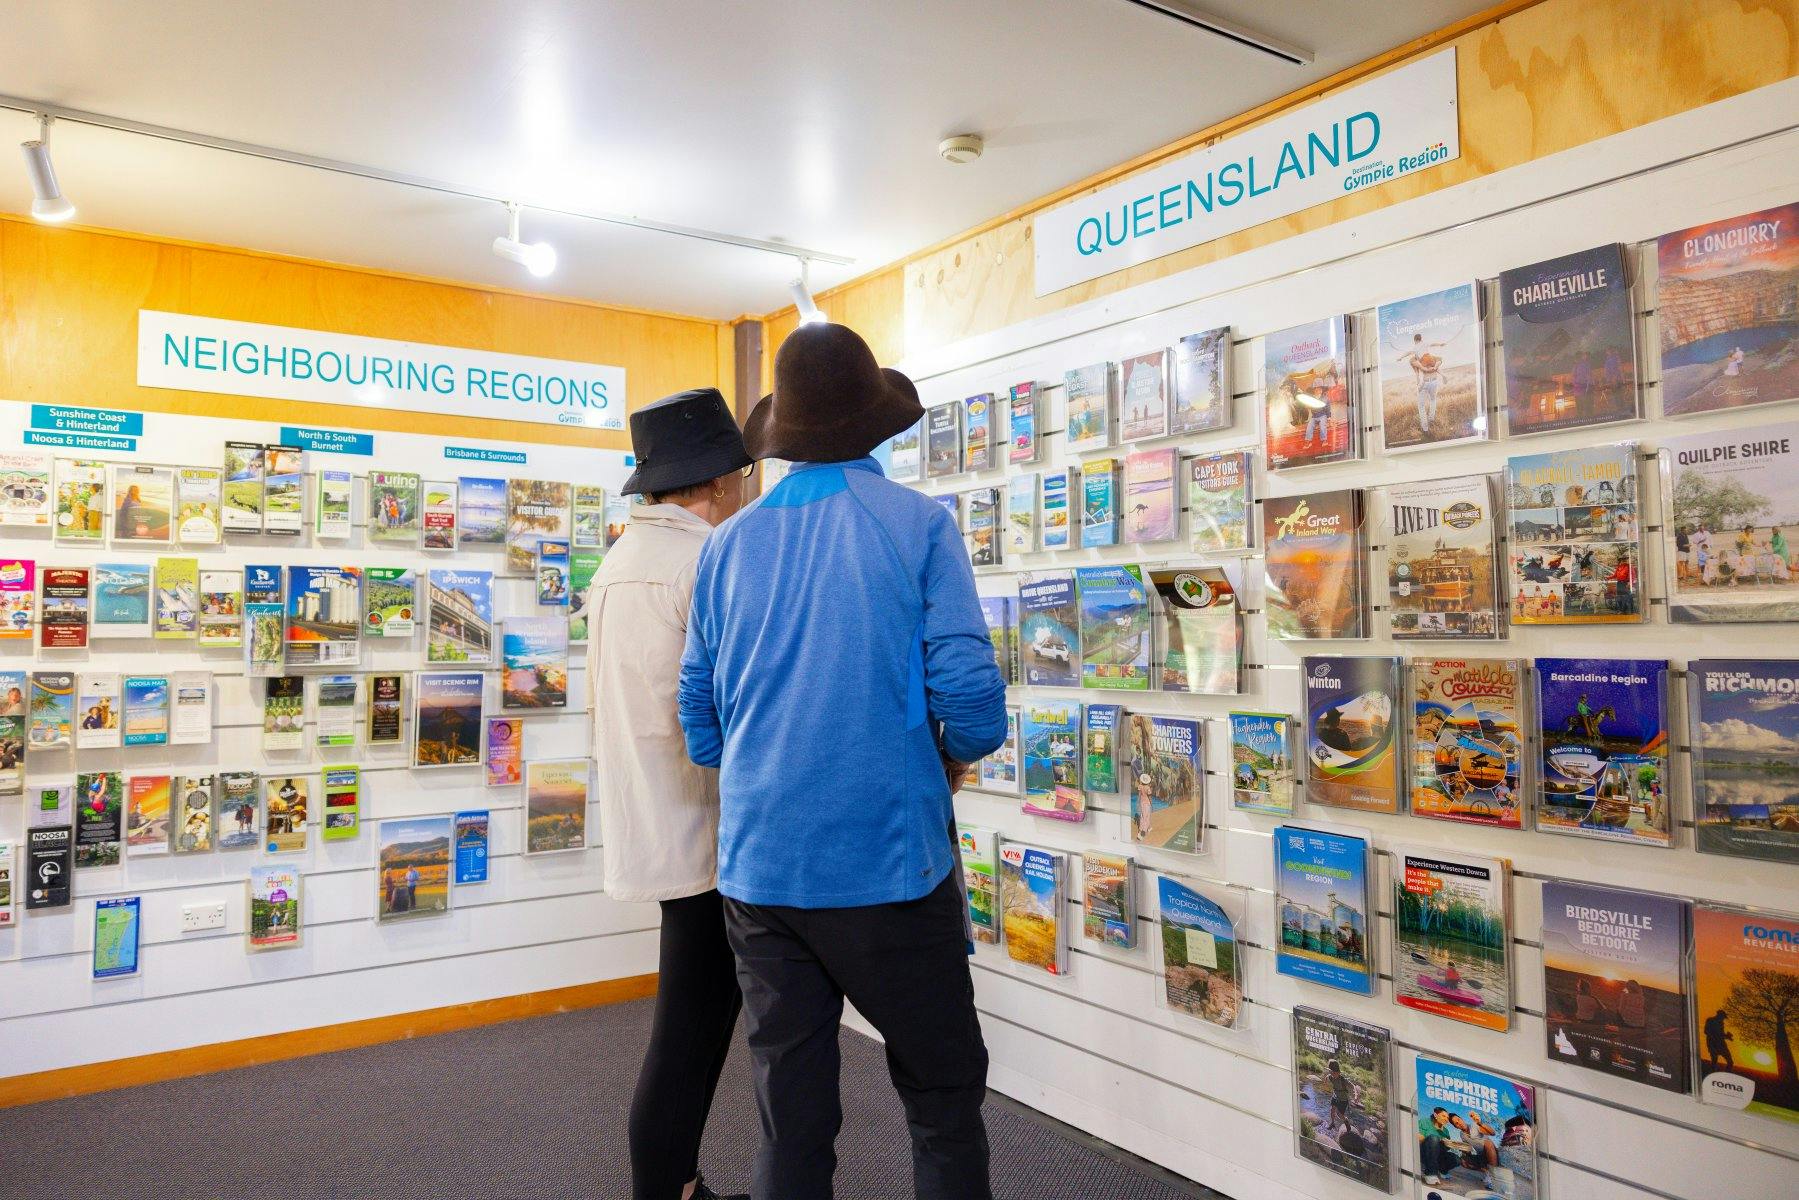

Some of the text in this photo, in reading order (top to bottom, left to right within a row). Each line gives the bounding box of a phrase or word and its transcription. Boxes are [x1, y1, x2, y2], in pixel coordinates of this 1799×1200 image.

[1344, 145, 1448, 191] Gympie Region
[1352, 160, 1384, 175] Destination
[1076, 111, 1381, 256] QUEENSLAND
[1683, 220, 1781, 258] CLONCURRY
[1513, 268, 1607, 306] CHARLEVILLE
[1396, 318, 1432, 335] Longreach
[1291, 339, 1321, 353] Outback
[1282, 345, 1329, 363] QUEENSLAND
[163, 333, 609, 409] NEIGHBOURING REGIONS
[49, 408, 127, 423] Sunshine Coast
[56, 419, 120, 432] & Hinterland
[31, 433, 129, 449] Noosa & Hinterland
[298, 430, 357, 443] North & South
[311, 440, 344, 451] Burnett
[1678, 438, 1791, 466] QUILPIE SHIRE
[446, 448, 525, 463] Brisbane & Surrounds
[1195, 461, 1239, 479] CAPE YORK
[372, 472, 418, 489] Touring
[1195, 475, 1239, 490] VISITORS GUIDE
[517, 505, 543, 516] VISITOR
[1307, 514, 1340, 528] Great
[1393, 504, 1439, 537] LIVE IT
[1296, 526, 1337, 538] Inland Way
[442, 576, 481, 585] IPSWICH
[1037, 583, 1068, 596] QUEENSLAND
[1434, 661, 1466, 669] ACTION
[1453, 663, 1516, 685] Matilda
[1551, 673, 1648, 686] Barcaldine Region
[466, 678, 480, 686] RIM
[1308, 676, 1341, 690] Winton
[1442, 679, 1516, 697] Country
[1032, 707, 1068, 725] Cardwell
[1152, 723, 1192, 739] CHARTERS
[1232, 718, 1272, 735] Hughenden
[1152, 736, 1193, 755] TOWERS
[1248, 733, 1277, 748] Region
[1549, 747, 1583, 755] Welcome
[34, 832, 66, 840] NOOSA
[1003, 850, 1021, 861] VIVA
[1029, 855, 1050, 865] OUTBACK
[1313, 856, 1325, 865] Visit
[1407, 858, 1488, 878] Experience Western Downs
[1407, 869, 1417, 877] It's
[1306, 872, 1333, 886] REGION
[1407, 876, 1440, 888] people that
[1407, 884, 1423, 892] make
[1168, 894, 1225, 920] Tropical North
[1171, 907, 1222, 930] Queensland
[1566, 904, 1652, 931] BIRDSVILLE
[1577, 921, 1641, 942] BEDOURIE
[1582, 932, 1638, 953] BETOOTA
[1305, 1027, 1339, 1043] CENTRAL
[1305, 1035, 1339, 1049] QUEENSLAND
[1345, 1041, 1372, 1055] EXPLORE
[1345, 1047, 1359, 1057] MORE
[1444, 1070, 1469, 1080] explore
[1425, 1071, 1498, 1103] SAPPHIRE
[1711, 1079, 1744, 1093] roma
[1426, 1085, 1498, 1115] GEMFIELDS
[1518, 1089, 1527, 1101] FREE
